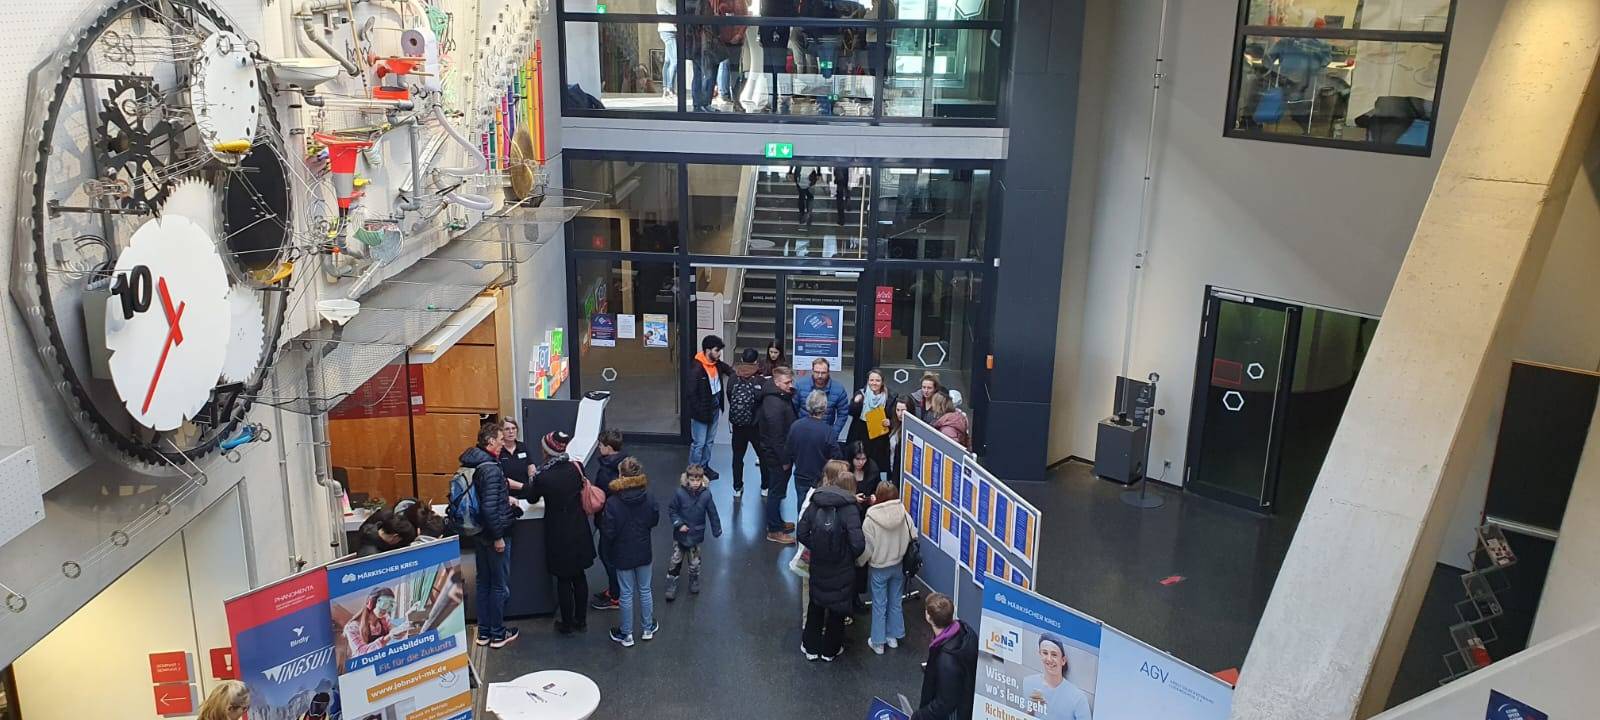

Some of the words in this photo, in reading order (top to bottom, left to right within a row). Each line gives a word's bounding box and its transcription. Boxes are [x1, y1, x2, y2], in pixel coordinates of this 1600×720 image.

[111, 265, 153, 320] 10
[400, 560, 419, 570] KREIS
[361, 651, 387, 665] Duale
[388, 634, 435, 655] Ausbildung
[261, 646, 336, 684] WINGSUIT
[378, 662, 391, 672] Fit
[985, 664, 1019, 689] Wissen,
[1140, 661, 1169, 684] AGV
[1006, 688, 1025, 709] lang
[1027, 700, 1048, 715] geht
